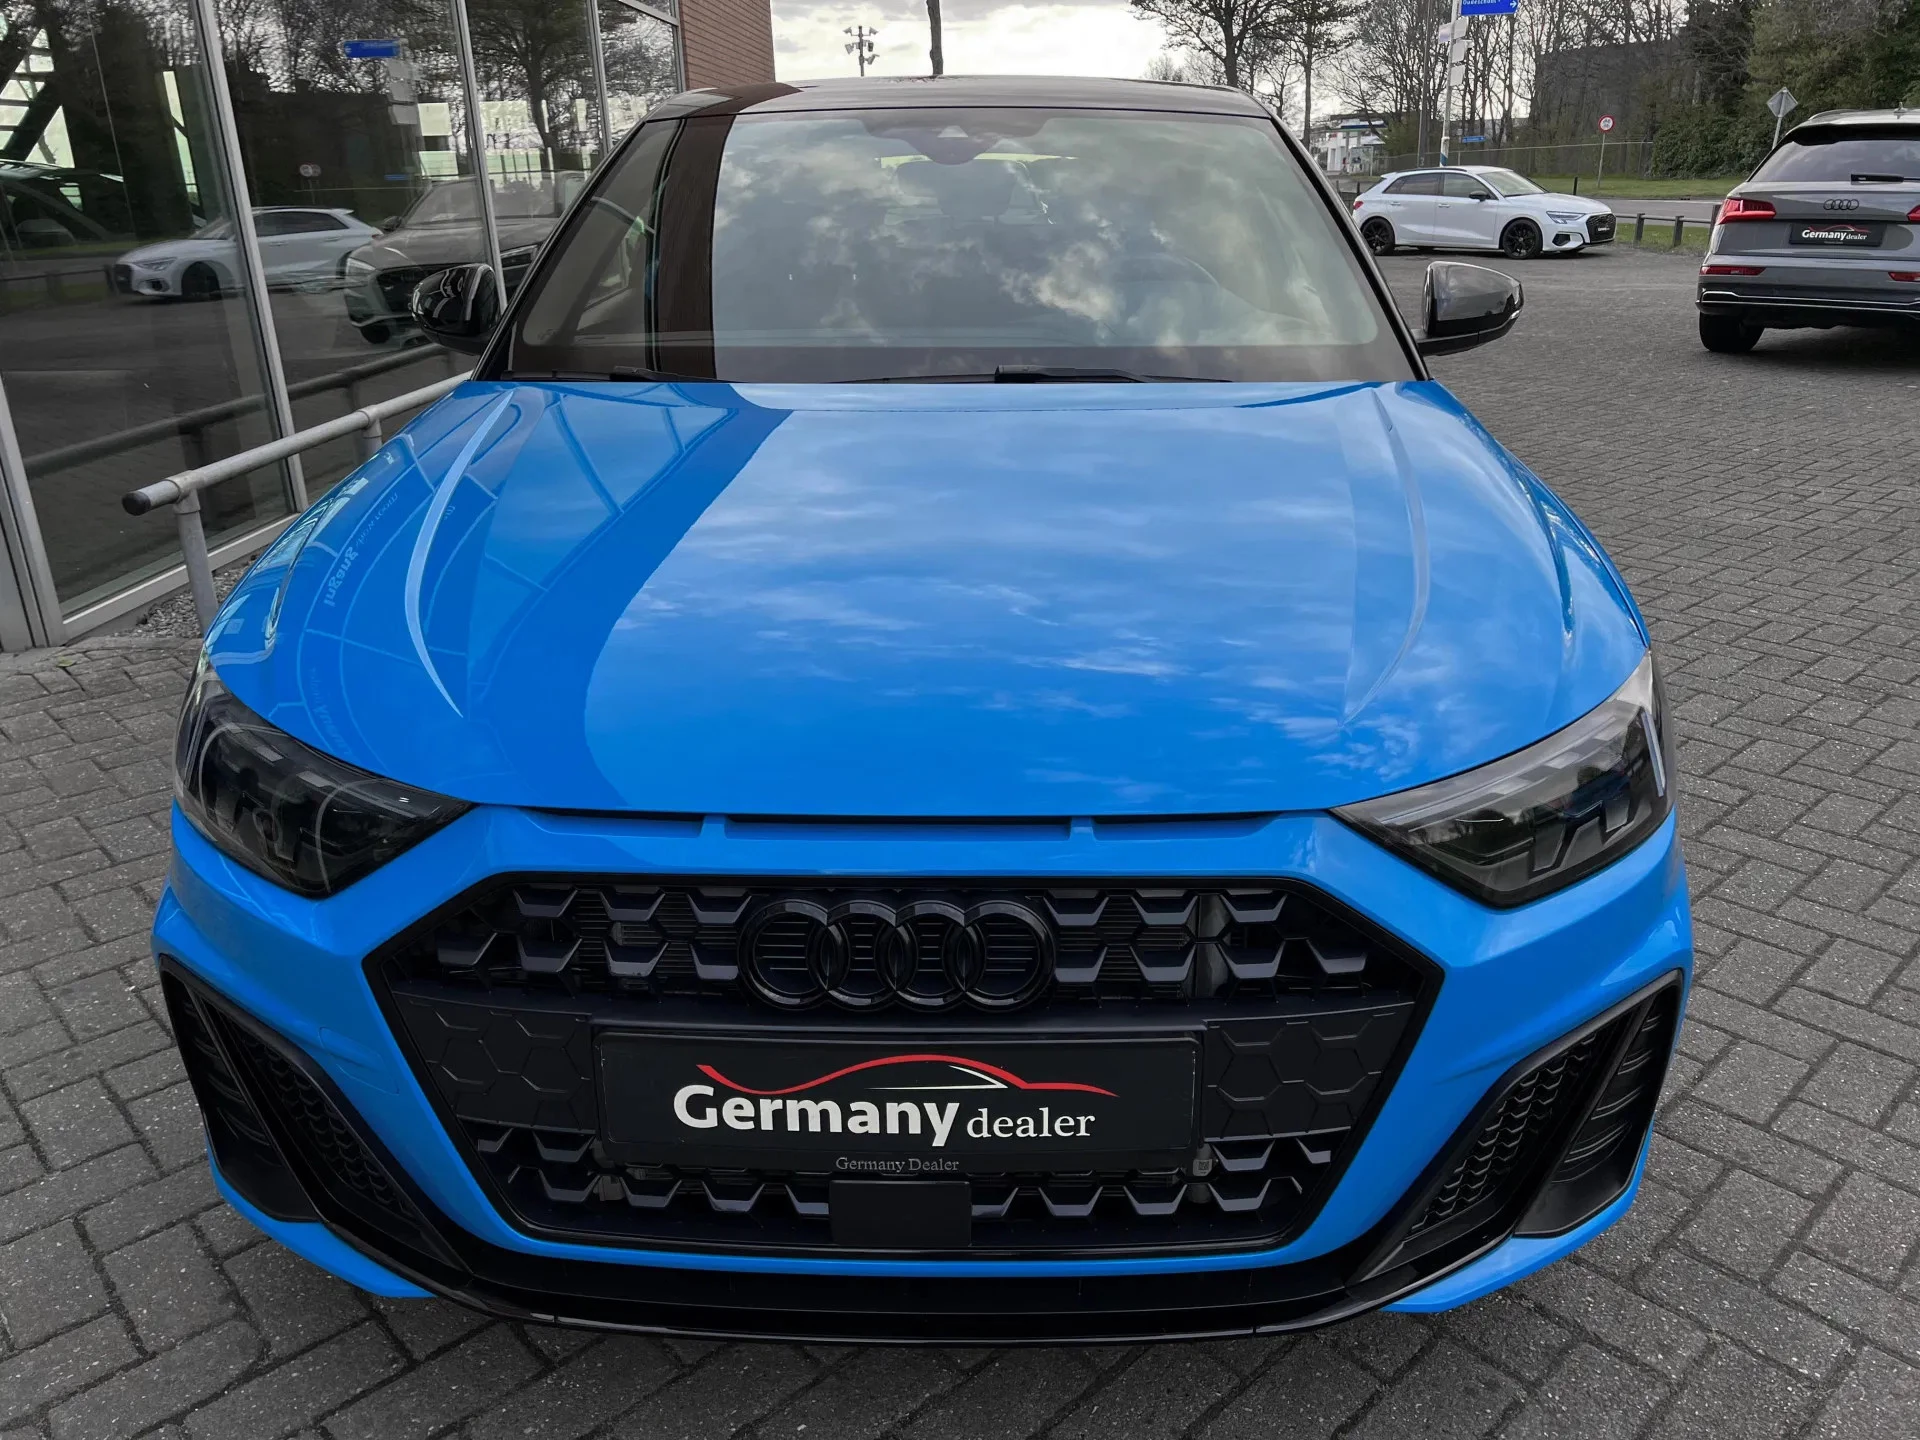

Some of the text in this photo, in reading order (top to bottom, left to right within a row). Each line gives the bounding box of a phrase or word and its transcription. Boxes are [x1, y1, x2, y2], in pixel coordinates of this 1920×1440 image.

[1802, 229, 1847, 241] Germany
[673, 1084, 1096, 1146] Germany dealer
[835, 1156, 959, 1173] Germany Dealer
